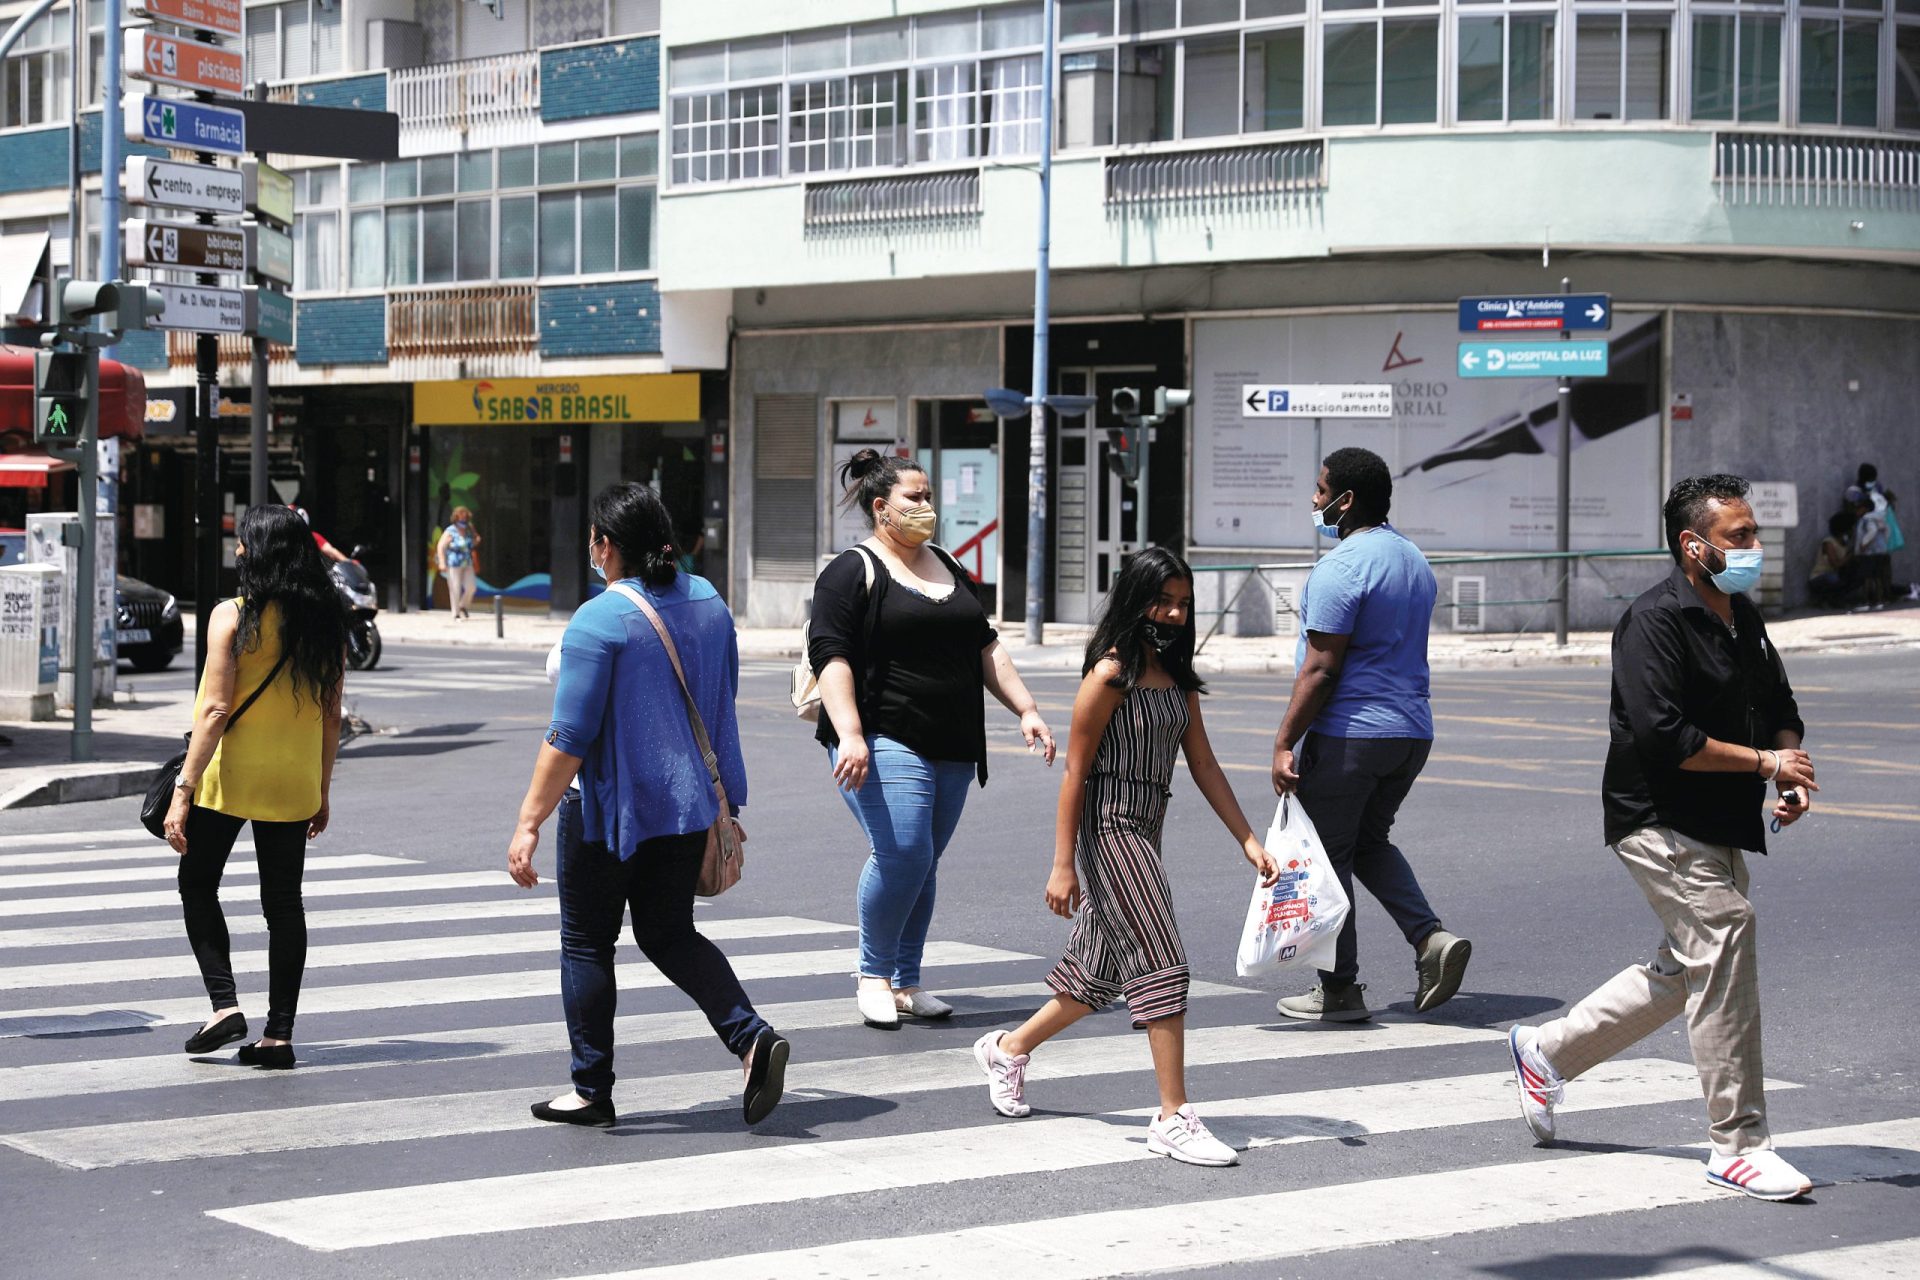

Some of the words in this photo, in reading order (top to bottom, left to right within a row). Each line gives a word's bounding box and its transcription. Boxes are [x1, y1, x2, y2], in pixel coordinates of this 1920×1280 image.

[198, 56, 241, 84] piscinas
[195, 117, 241, 145] farmácia
[163, 177, 193, 195] centro
[206, 184, 241, 203] emprego
[206, 233, 242, 251] biblioteca
[205, 251, 220, 265] José
[201, 295, 216, 308] Nuno
[1477, 301, 1508, 313] Clínica
[221, 312, 241, 325] Pereira
[1506, 350, 1561, 362] HOSPITAL
[1562, 350, 1578, 361] DA
[1580, 349, 1603, 361] LUZ
[536, 384, 580, 394] MERCADO
[1341, 390, 1375, 400] parque
[1377, 389, 1390, 399] de
[487, 396, 553, 420] SABOR
[560, 394, 632, 419] BRASIL
[1272, 393, 1285, 410] P
[1291, 402, 1390, 413] estacionamento
[1392, 400, 1447, 416] ARIAL
